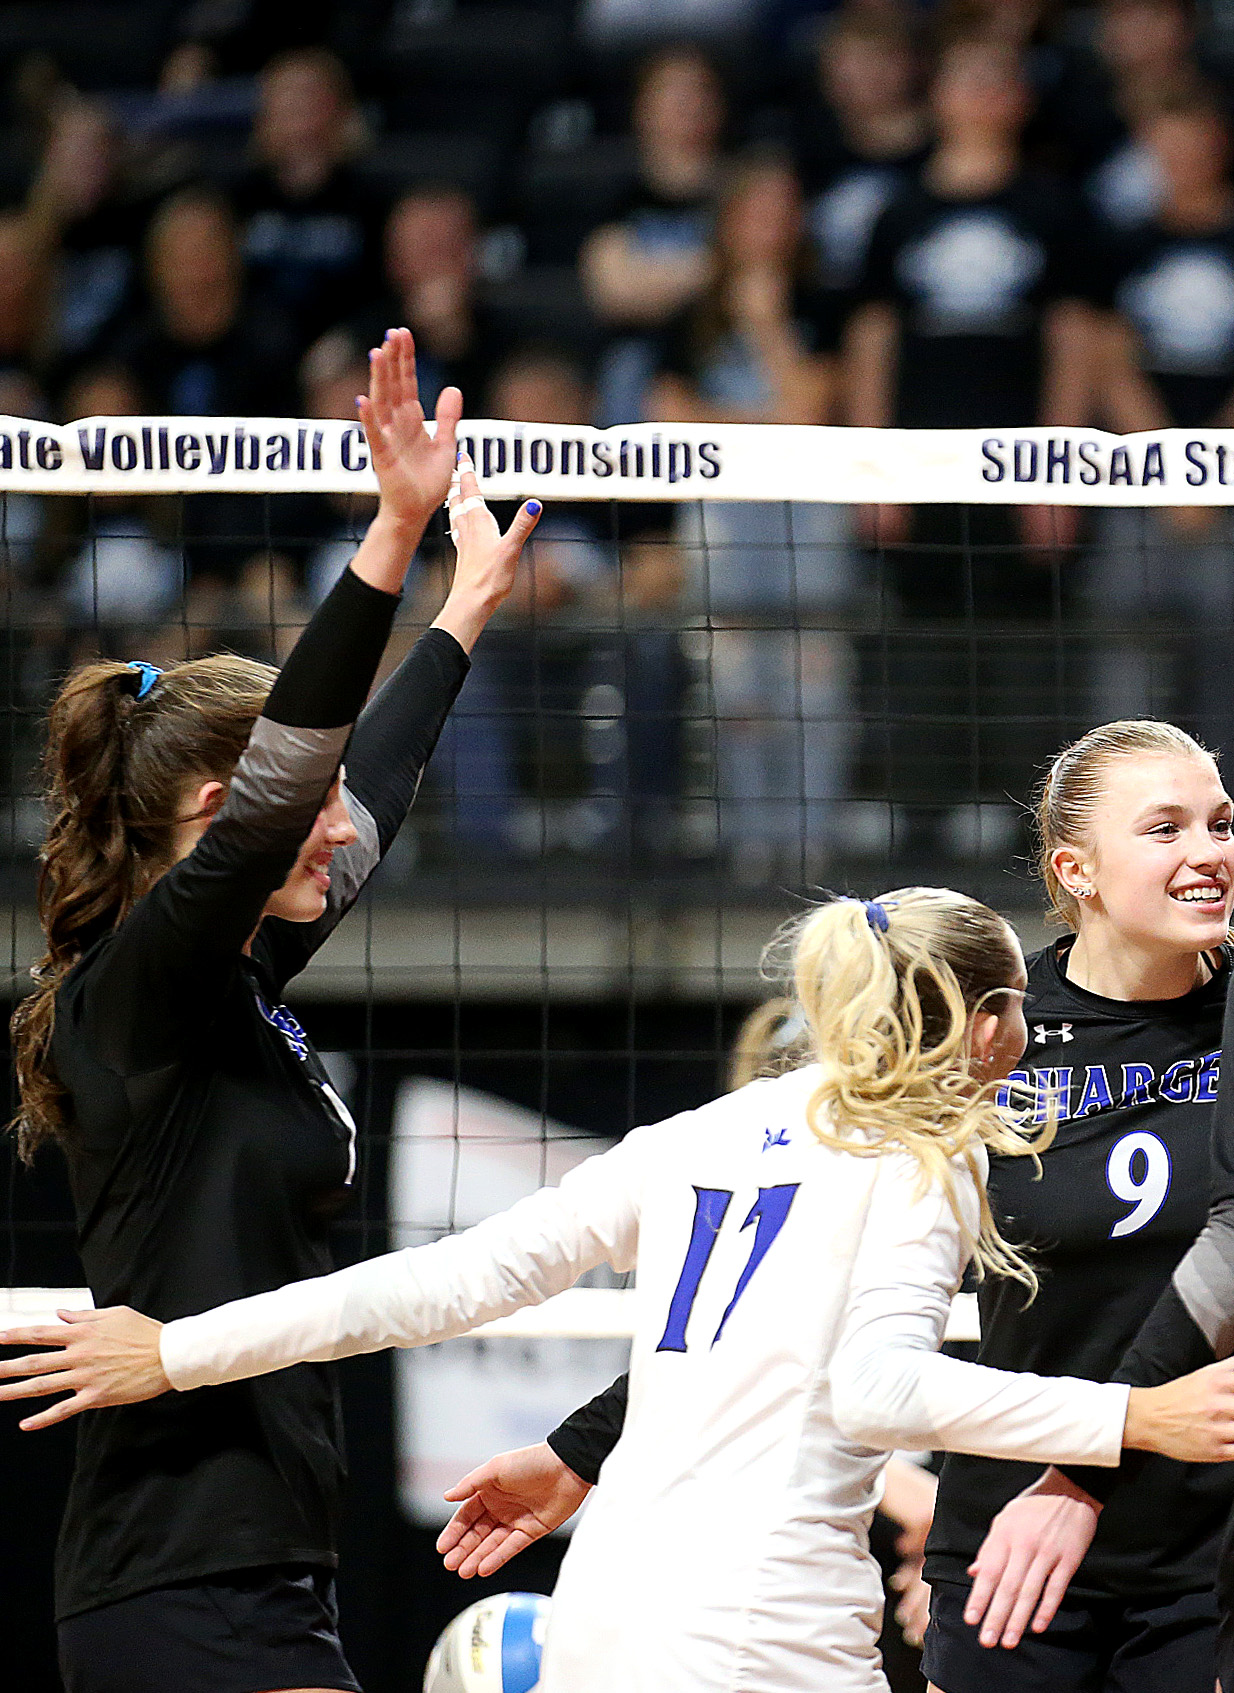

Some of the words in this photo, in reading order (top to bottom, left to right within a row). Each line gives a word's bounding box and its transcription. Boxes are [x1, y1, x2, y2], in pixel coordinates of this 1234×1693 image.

[77, 426, 324, 475] Volleyball
[340, 423, 721, 484] Cpionships
[981, 437, 1168, 486] SDHSAA
[1105, 1129, 1173, 1240] 9
